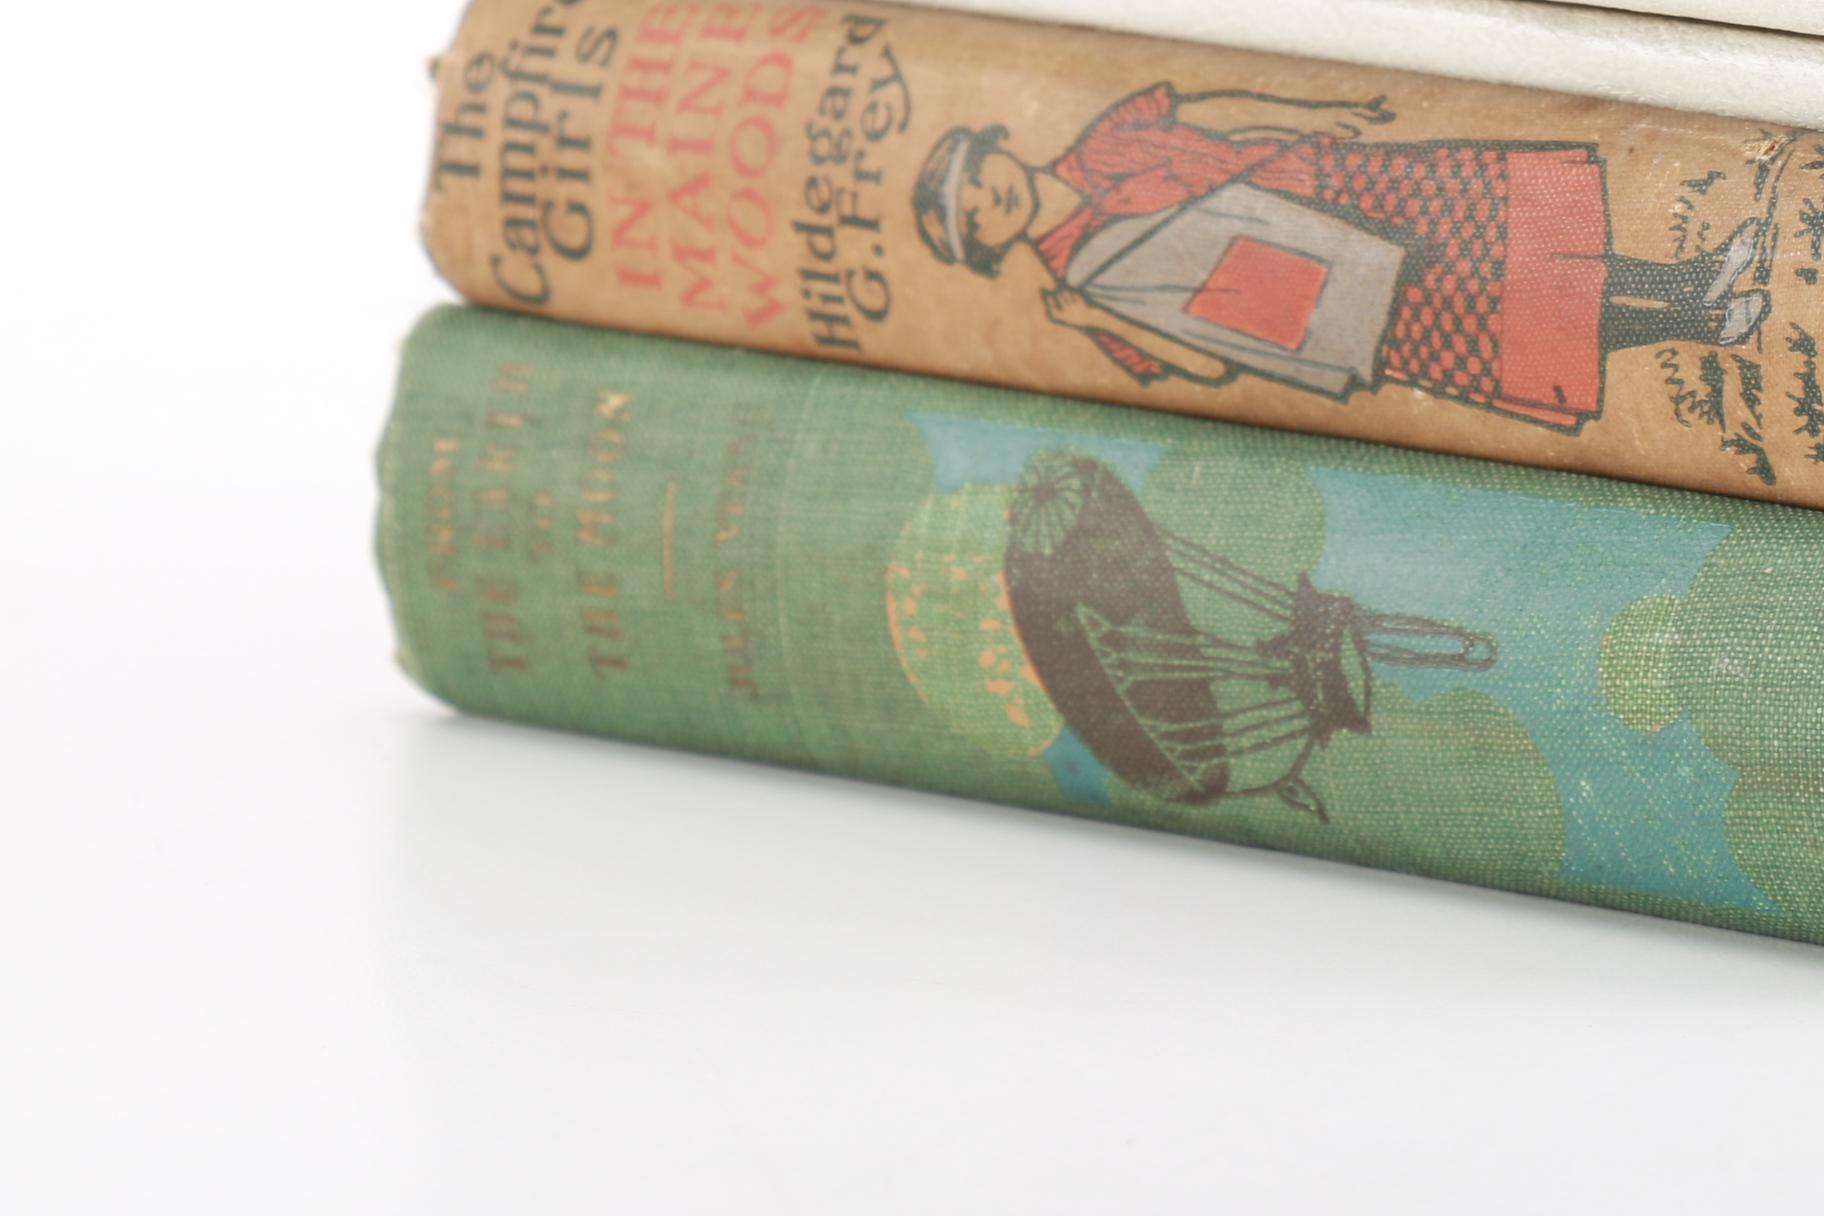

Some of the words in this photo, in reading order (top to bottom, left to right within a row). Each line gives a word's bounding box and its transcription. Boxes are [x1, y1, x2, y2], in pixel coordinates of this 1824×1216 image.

[434, 51, 495, 191] The
[537, 26, 619, 261] Girls
[606, 1, 701, 156] THE
[662, 1, 763, 315] MAINE
[724, 4, 828, 330] WOODS
[606, 192, 662, 292] IN
[790, 14, 888, 352] Hildegard
[574, 388, 634, 548] MOON
